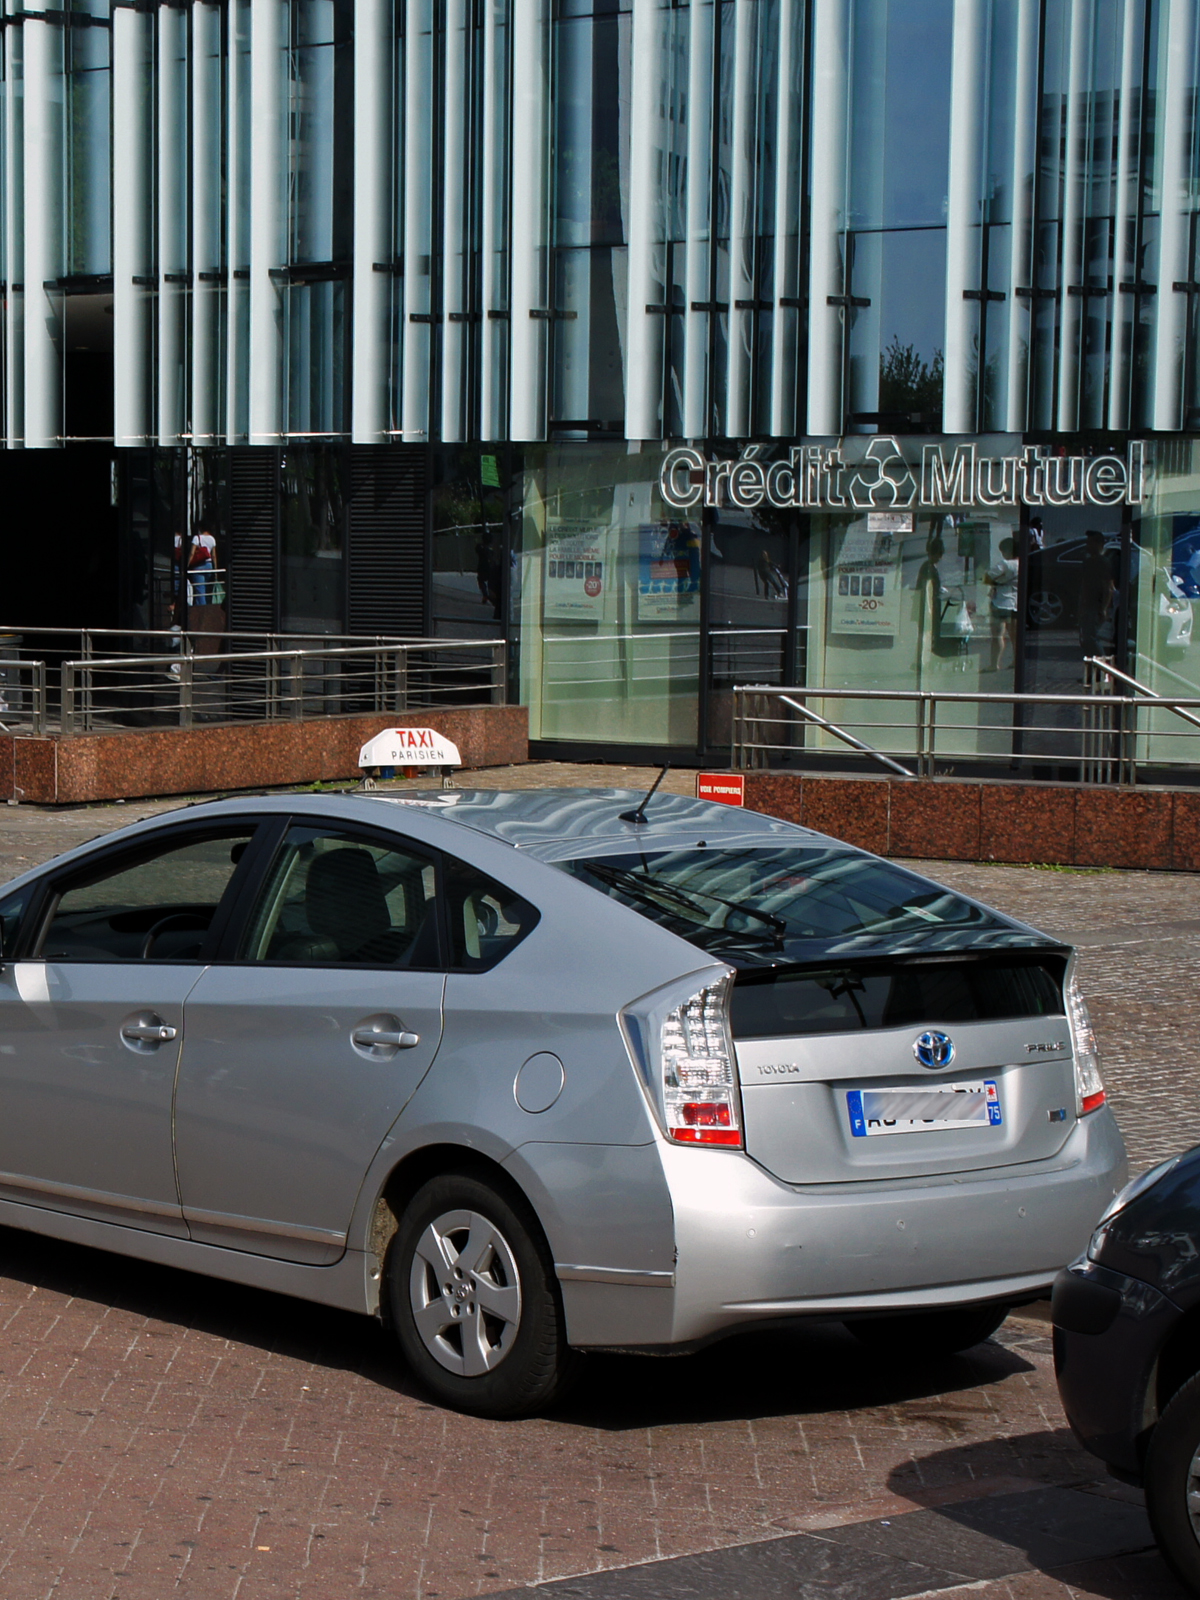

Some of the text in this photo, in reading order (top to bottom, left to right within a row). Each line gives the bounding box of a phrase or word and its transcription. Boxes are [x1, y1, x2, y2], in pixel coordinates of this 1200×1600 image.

[660, 440, 1146, 508] Crédit Mutuel
[395, 731, 434, 748] TAXI
[391, 750, 444, 760] PARISIEN
[1024, 1041, 1067, 1054] PRIUS
[757, 1063, 800, 1075] TOYOTA
[988, 1106, 1000, 1120] 75
[854, 1119, 862, 1129] F
